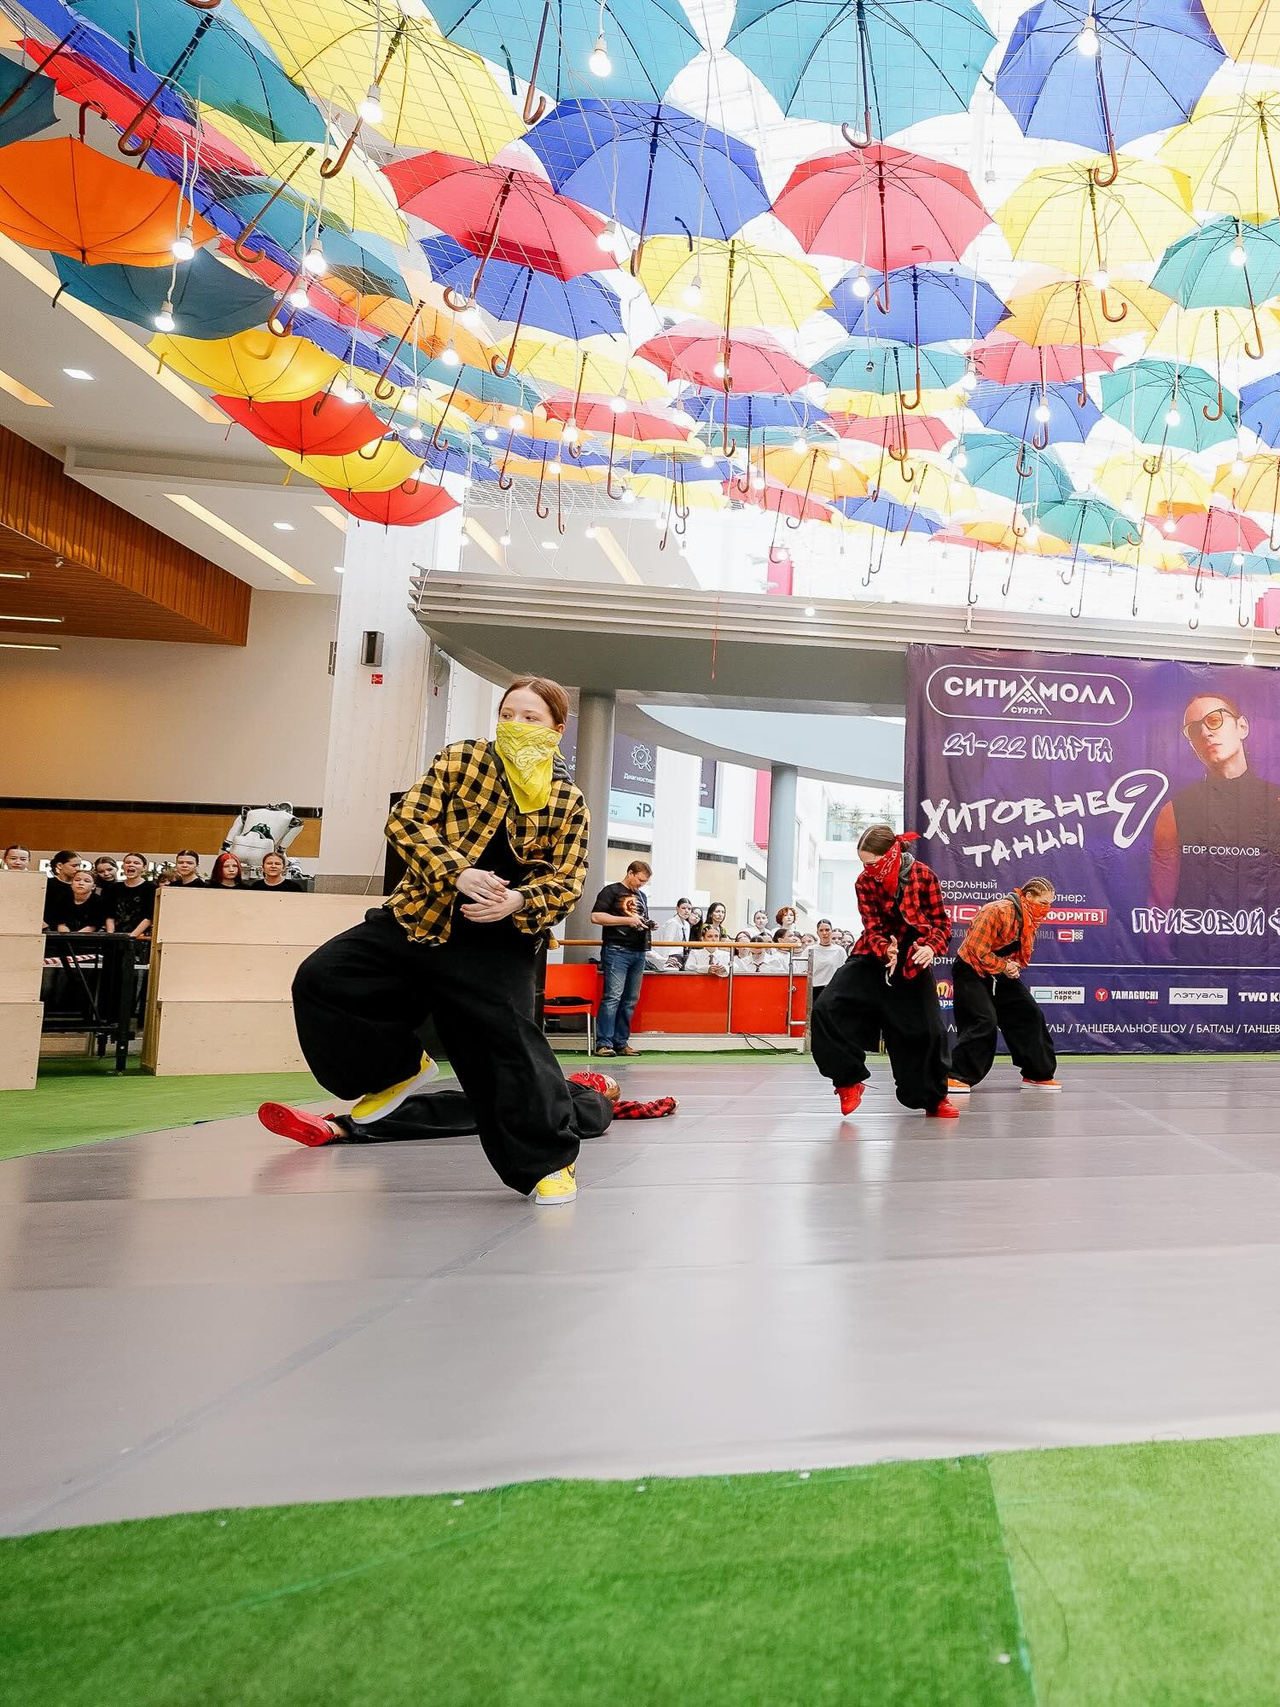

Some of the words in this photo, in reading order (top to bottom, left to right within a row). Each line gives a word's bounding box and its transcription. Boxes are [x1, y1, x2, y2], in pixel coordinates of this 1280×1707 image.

[944, 676, 1017, 699] СИТИ
[1039, 681, 1116, 705] МОЛЛ
[1011, 706, 1044, 715] СУРГУТ
[942, 733, 1027, 759] 21-22
[1032, 735, 1113, 763] МАРТА
[920, 791, 1110, 844] ХИТОВЫЕ
[962, 823, 1085, 867] ТАНЦЫ
[1182, 845, 1207, 855] ЕГОР
[1209, 846, 1260, 856] СОКОЛОВ
[939, 879, 998, 892] еральный
[1131, 907, 1266, 936] ПРИЗОВОЙ
[1111, 990, 1159, 1000] YAMAGUCHI
[1238, 991, 1269, 1002] TWO
[1075, 1024, 1158, 1034] ТАНЦЕВАЛЬНОЕ
[1160, 1024, 1187, 1034] ШОУ
[1197, 1024, 1234, 1034] БАТТЛЫ
